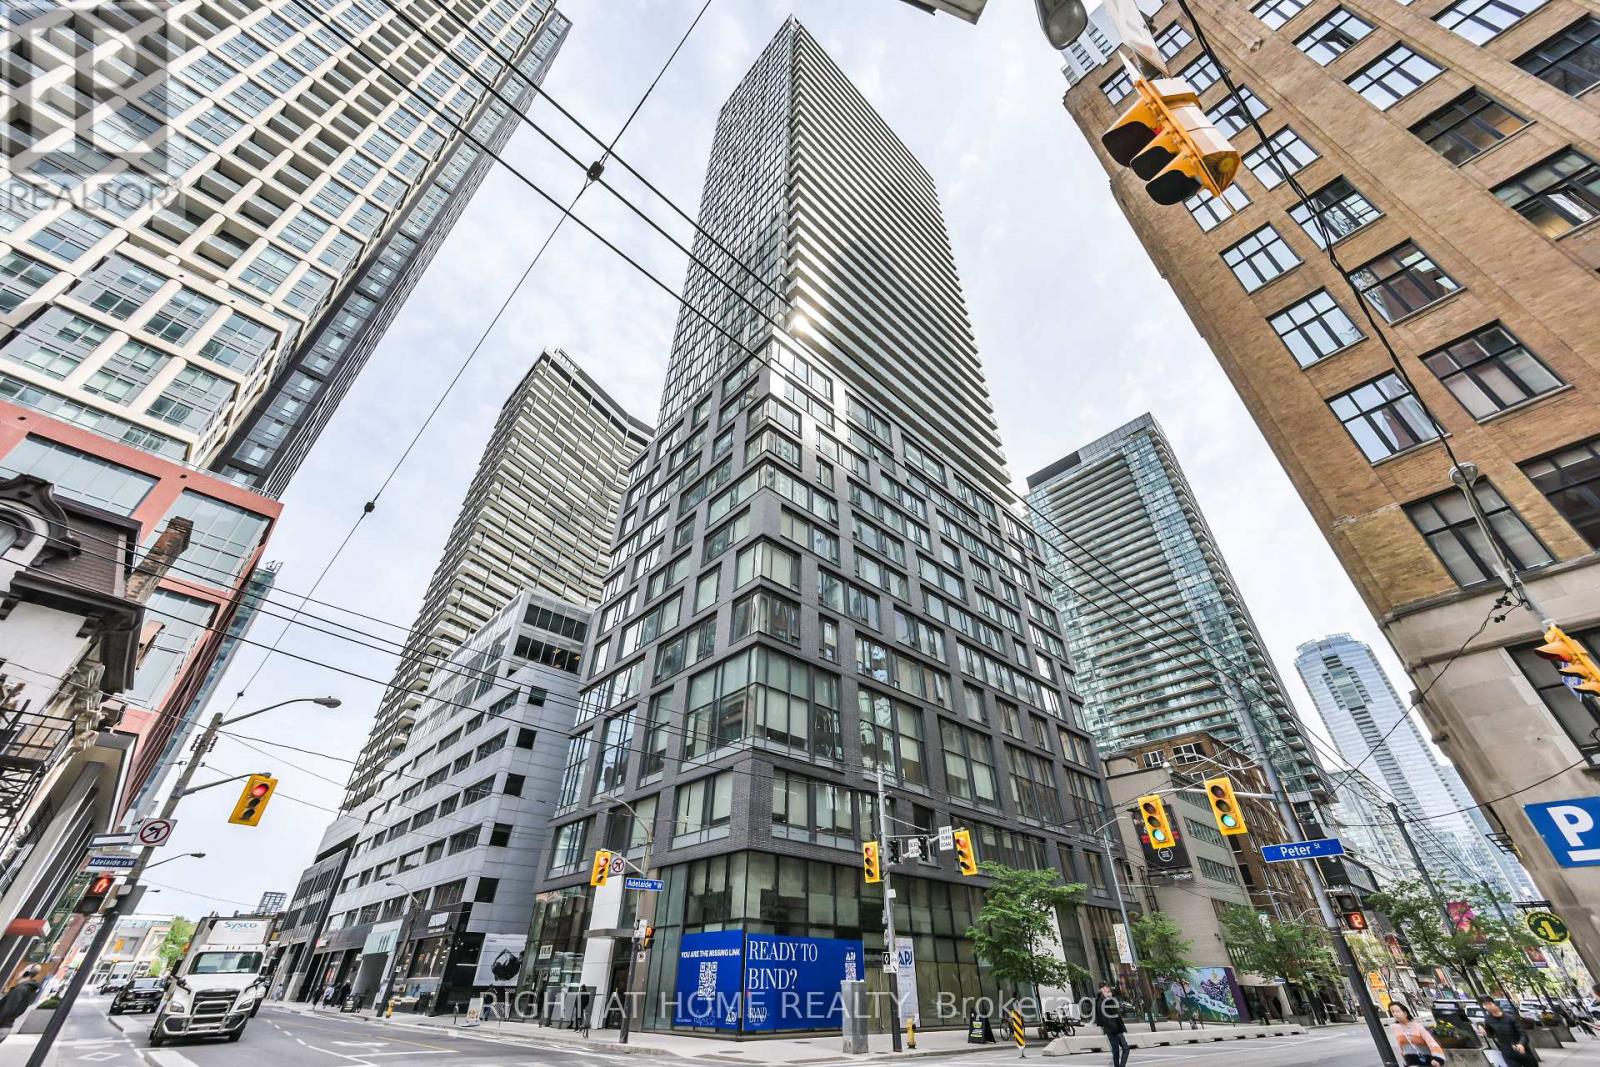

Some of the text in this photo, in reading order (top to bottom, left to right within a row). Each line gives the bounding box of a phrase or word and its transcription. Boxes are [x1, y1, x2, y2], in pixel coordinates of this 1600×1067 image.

[1546, 805, 1594, 847] P
[1280, 845, 1311, 858] Peter
[90, 858, 120, 866] Adelaide
[628, 879, 652, 889] Adelaide
[690, 950, 699, 958] ARE
[700, 949, 709, 957] THE
[709, 948, 729, 957] MISSING
[729, 948, 740, 956] LINK
[748, 940, 818, 962] READY TO
[748, 967, 798, 989] BIND?
